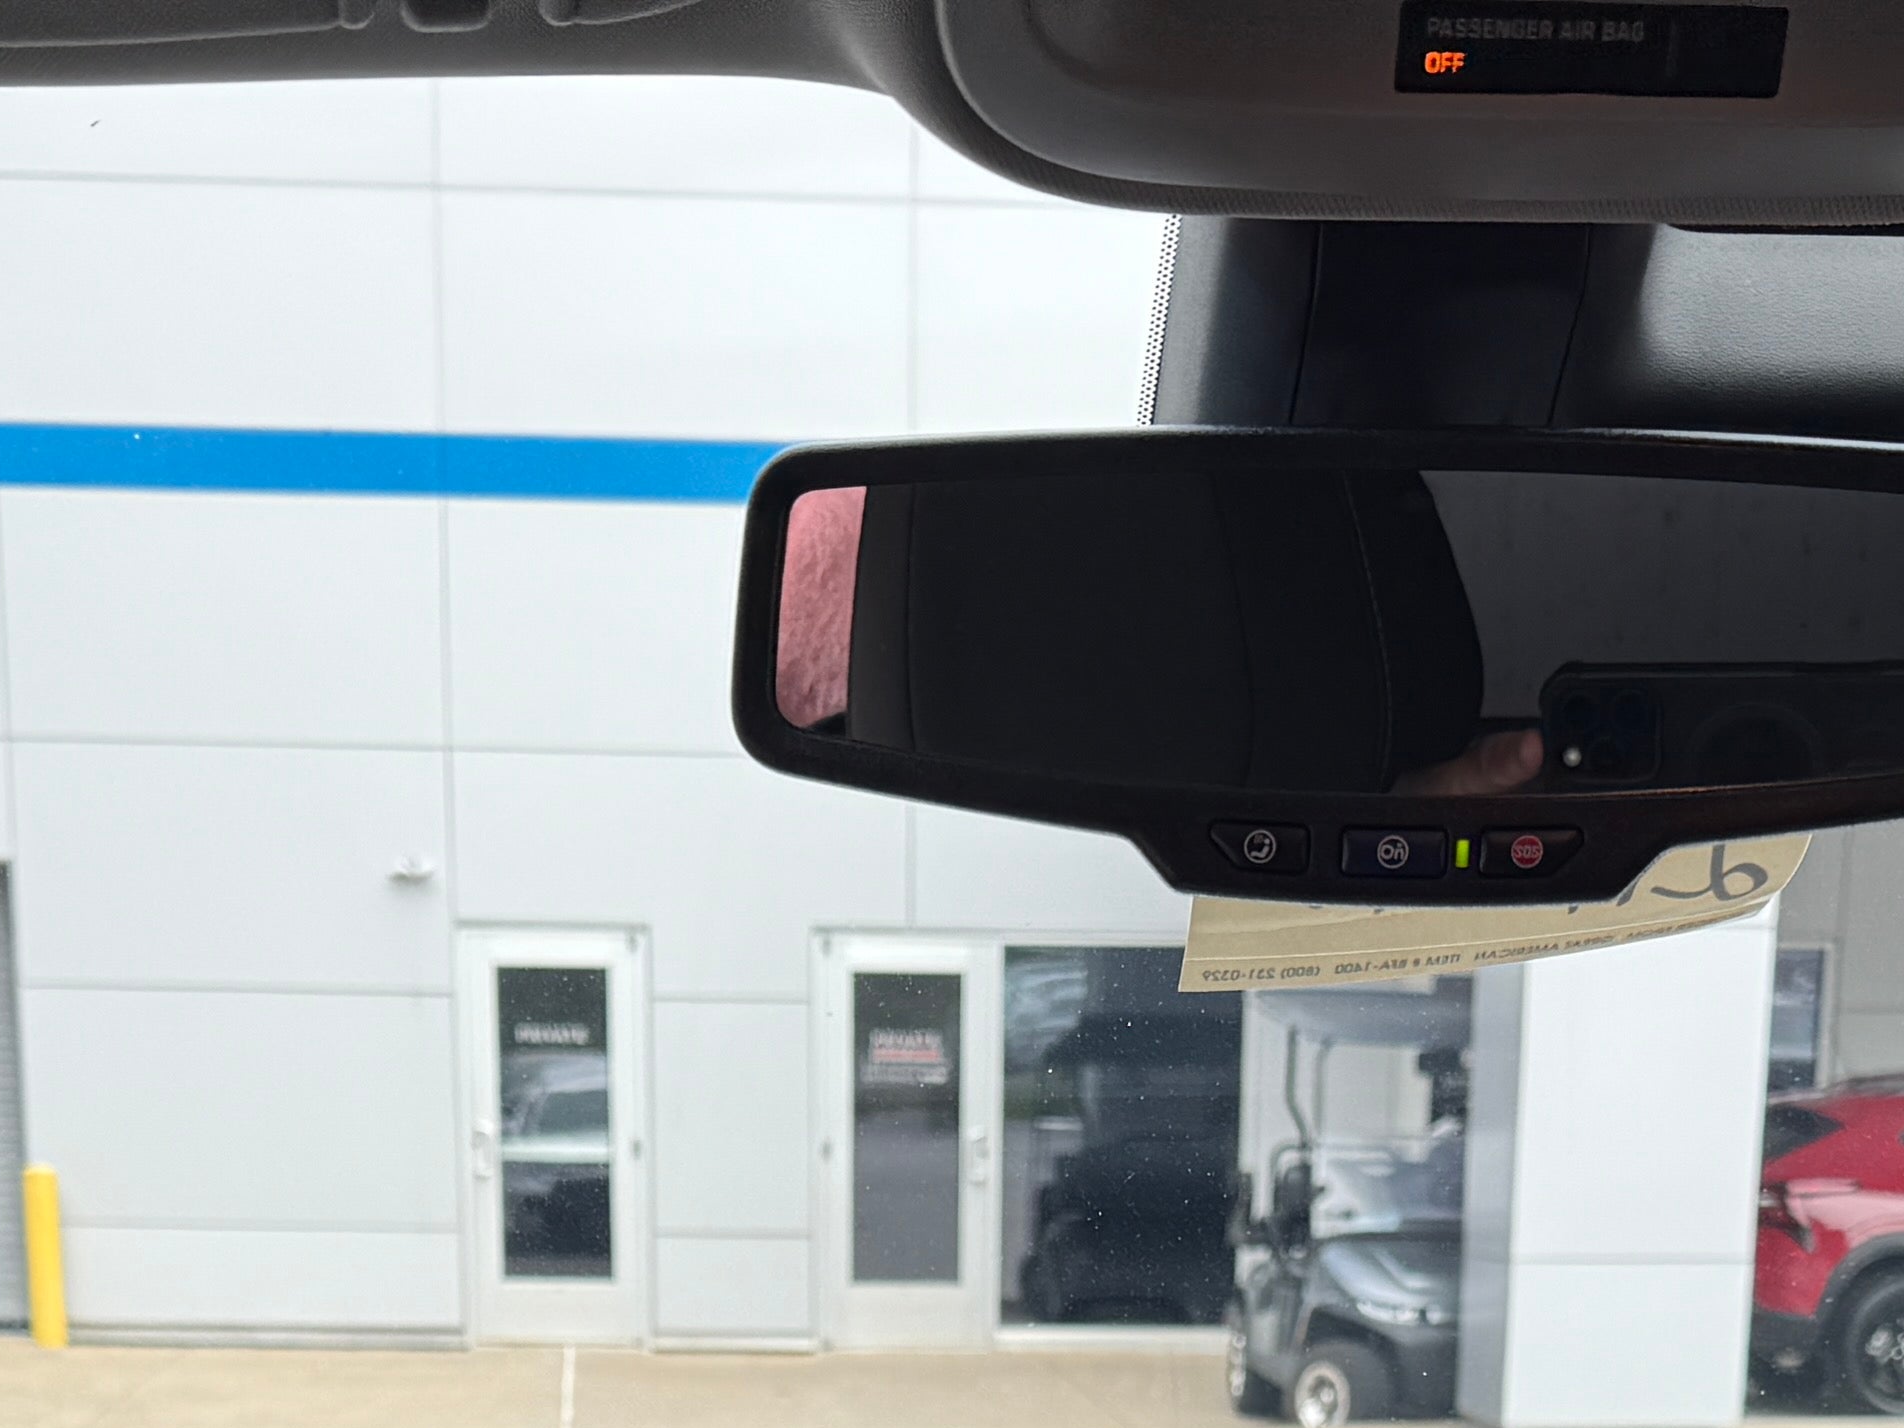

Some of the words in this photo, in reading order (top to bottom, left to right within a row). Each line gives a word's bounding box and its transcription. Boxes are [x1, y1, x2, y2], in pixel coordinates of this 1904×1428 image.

[1427, 17, 1554, 40] PASSENGER
[1559, 20, 1595, 41] AIR
[1601, 20, 1645, 42] BAG
[1424, 51, 1466, 74] OFF
[1514, 844, 1541, 859] SOS
